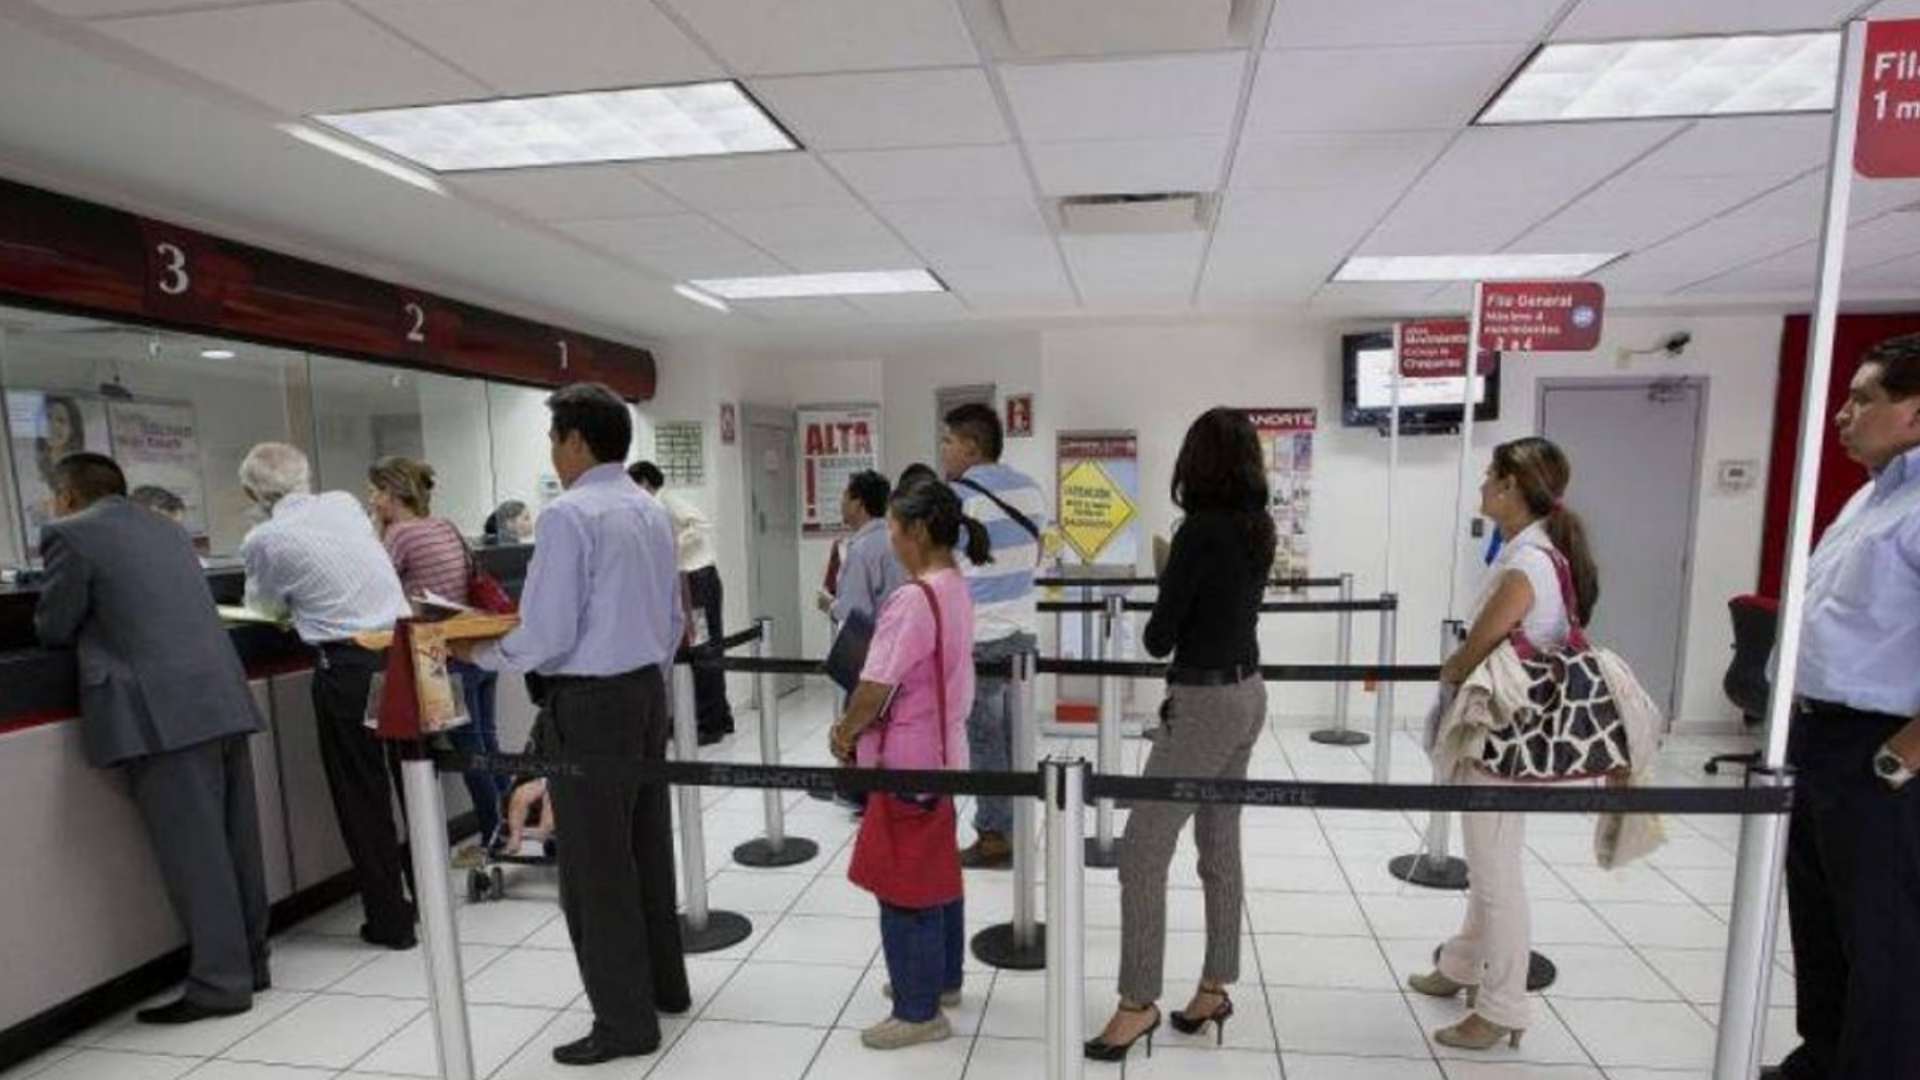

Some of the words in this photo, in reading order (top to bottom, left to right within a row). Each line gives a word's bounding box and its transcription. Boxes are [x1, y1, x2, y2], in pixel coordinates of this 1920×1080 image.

[1874, 52, 1920, 80] Fil
[1874, 90, 1887, 120] 1
[157, 241, 189, 295] 3
[1518, 292, 1573, 308] General
[405, 303, 424, 342] 2
[557, 340, 568, 369] 1
[806, 421, 873, 456] ALTA
